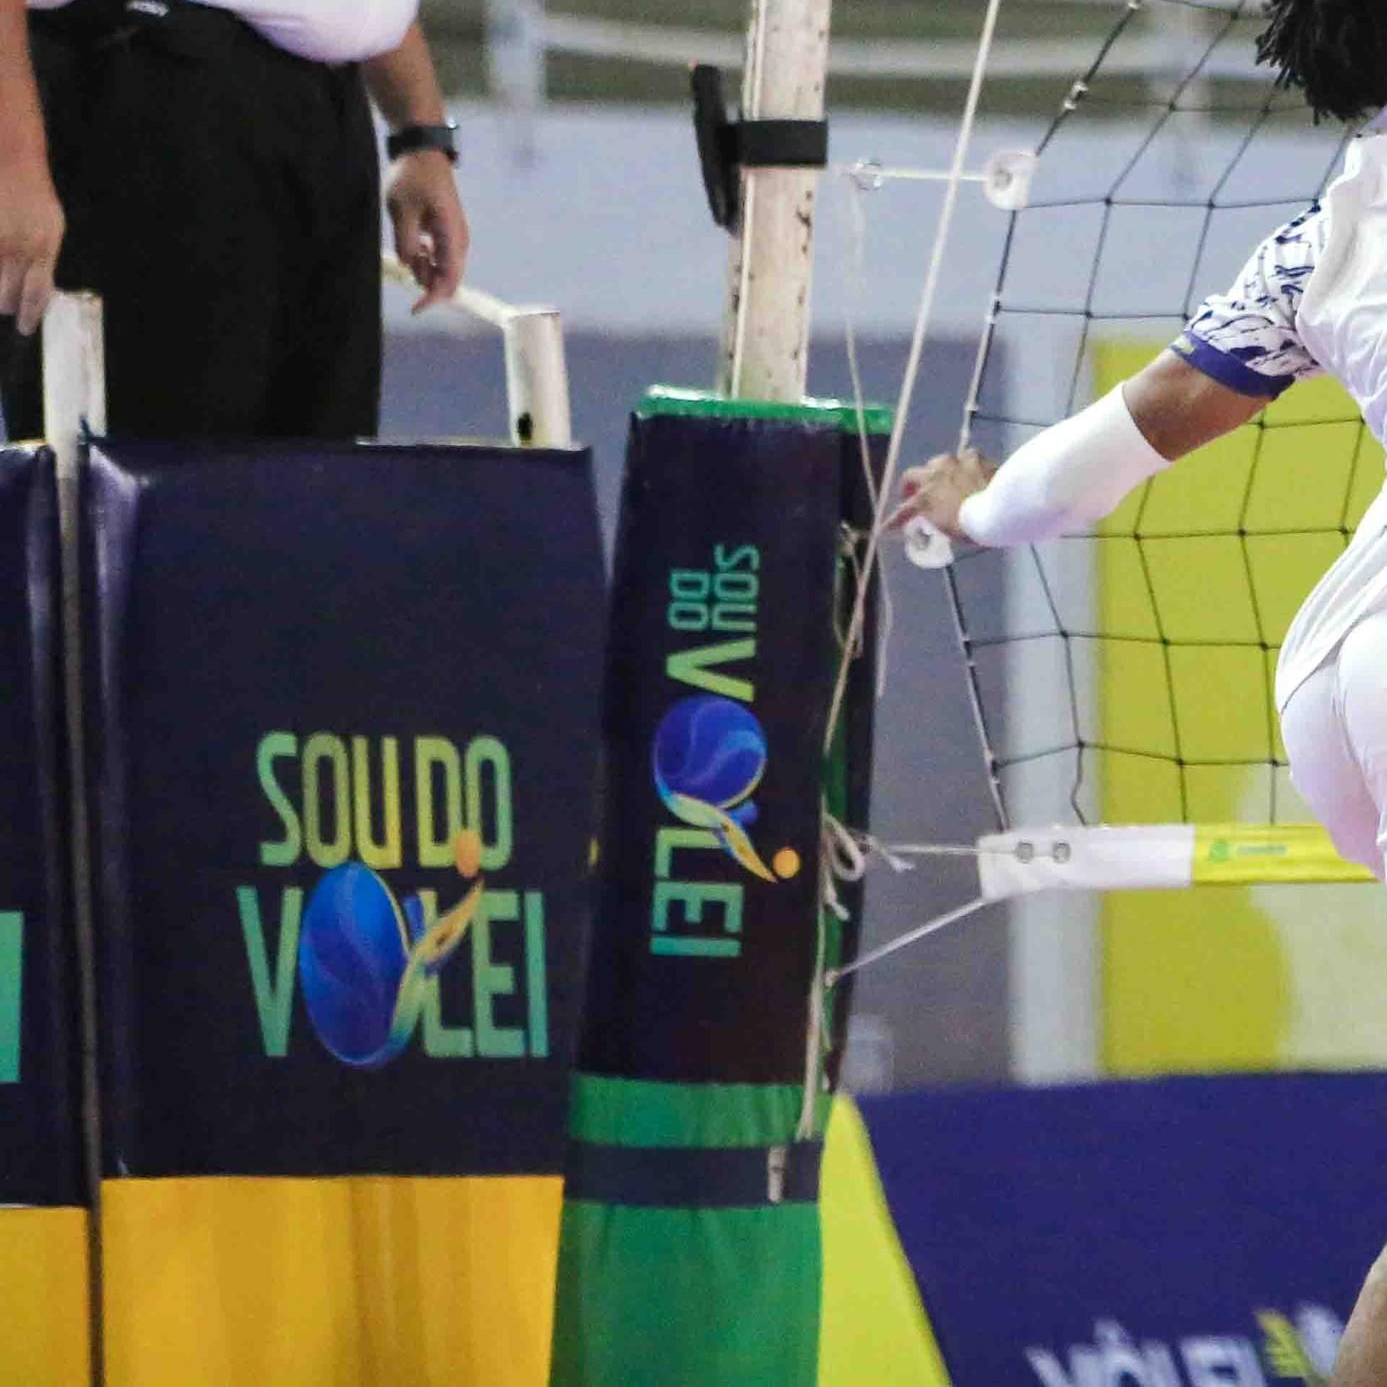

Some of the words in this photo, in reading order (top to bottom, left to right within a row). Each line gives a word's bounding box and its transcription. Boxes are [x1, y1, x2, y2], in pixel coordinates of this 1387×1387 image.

[667, 570, 706, 632] DO
[708, 543, 758, 634] SOU
[256, 732, 400, 868] SOU
[418, 735, 511, 868] DO
